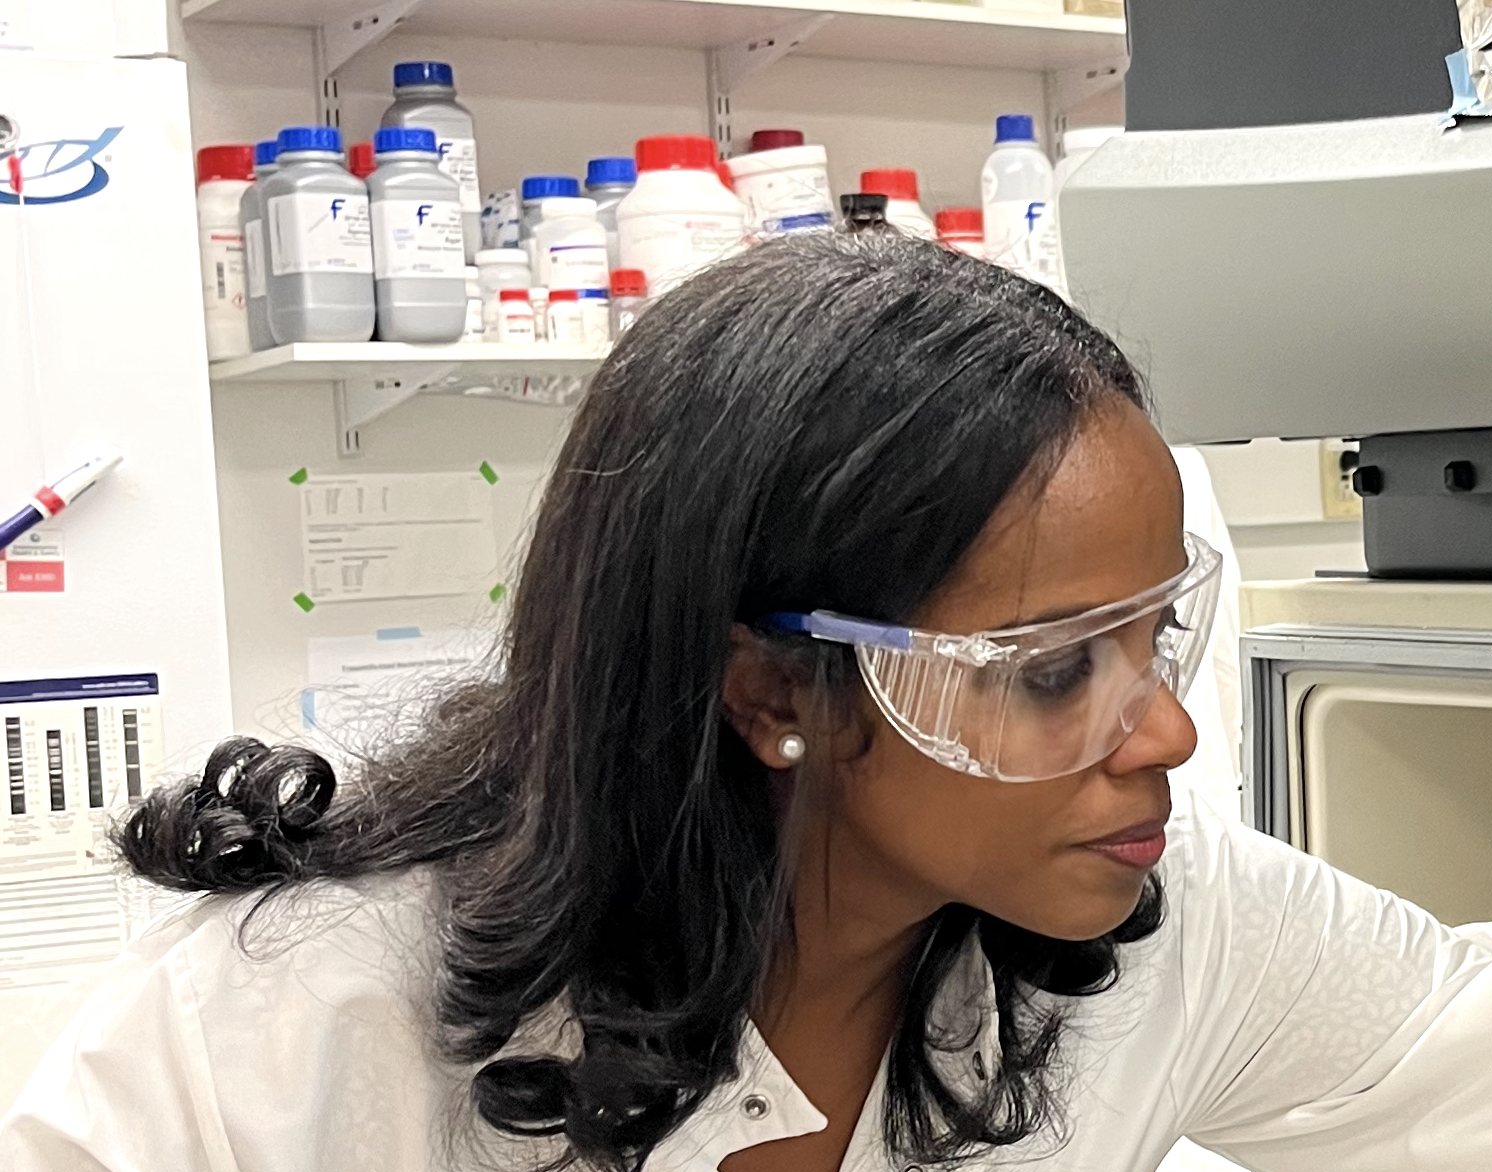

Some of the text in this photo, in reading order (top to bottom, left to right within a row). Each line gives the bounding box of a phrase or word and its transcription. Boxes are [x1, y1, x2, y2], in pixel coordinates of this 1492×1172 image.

[439, 142, 454, 162] F
[331, 198, 346, 221] F
[415, 204, 433, 226] F
[1024, 201, 1046, 233] F
